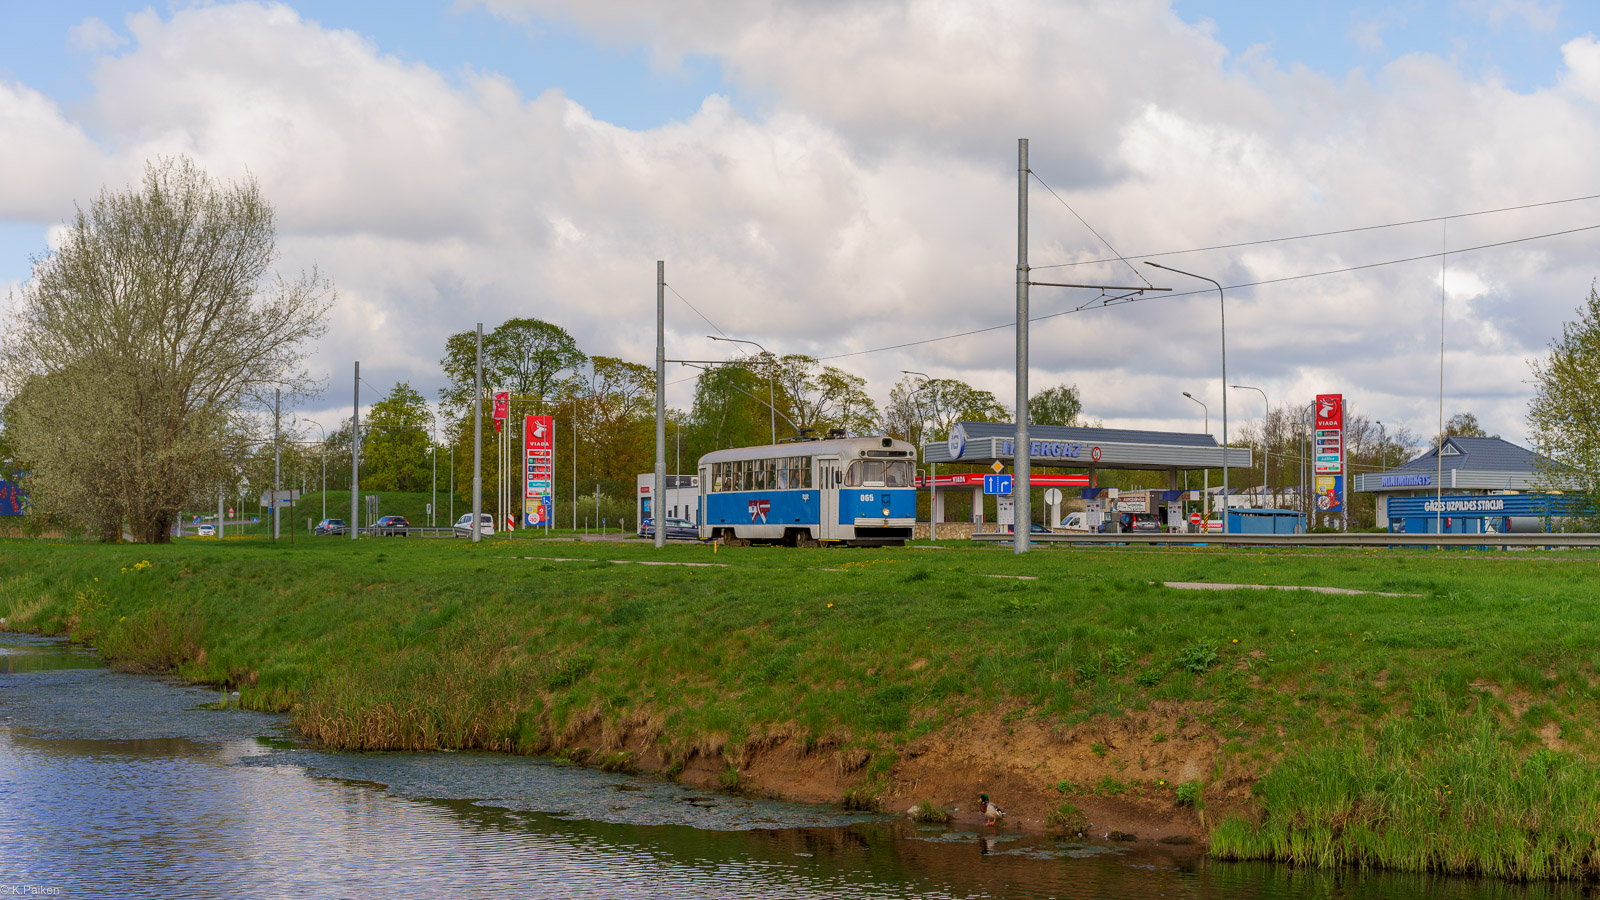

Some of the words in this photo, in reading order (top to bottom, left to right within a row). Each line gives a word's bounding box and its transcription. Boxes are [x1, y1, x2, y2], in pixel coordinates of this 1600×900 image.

[1002, 440, 1083, 458] IERGAZ
[952, 475, 966, 483] VIADA
[1381, 474, 1432, 487] MINIMARKETS
[860, 494, 874, 502] 065
[1424, 499, 1446, 512] GĀZES
[1446, 499, 1477, 511] UZPILDES
[1477, 499, 1504, 511] STACIJA
